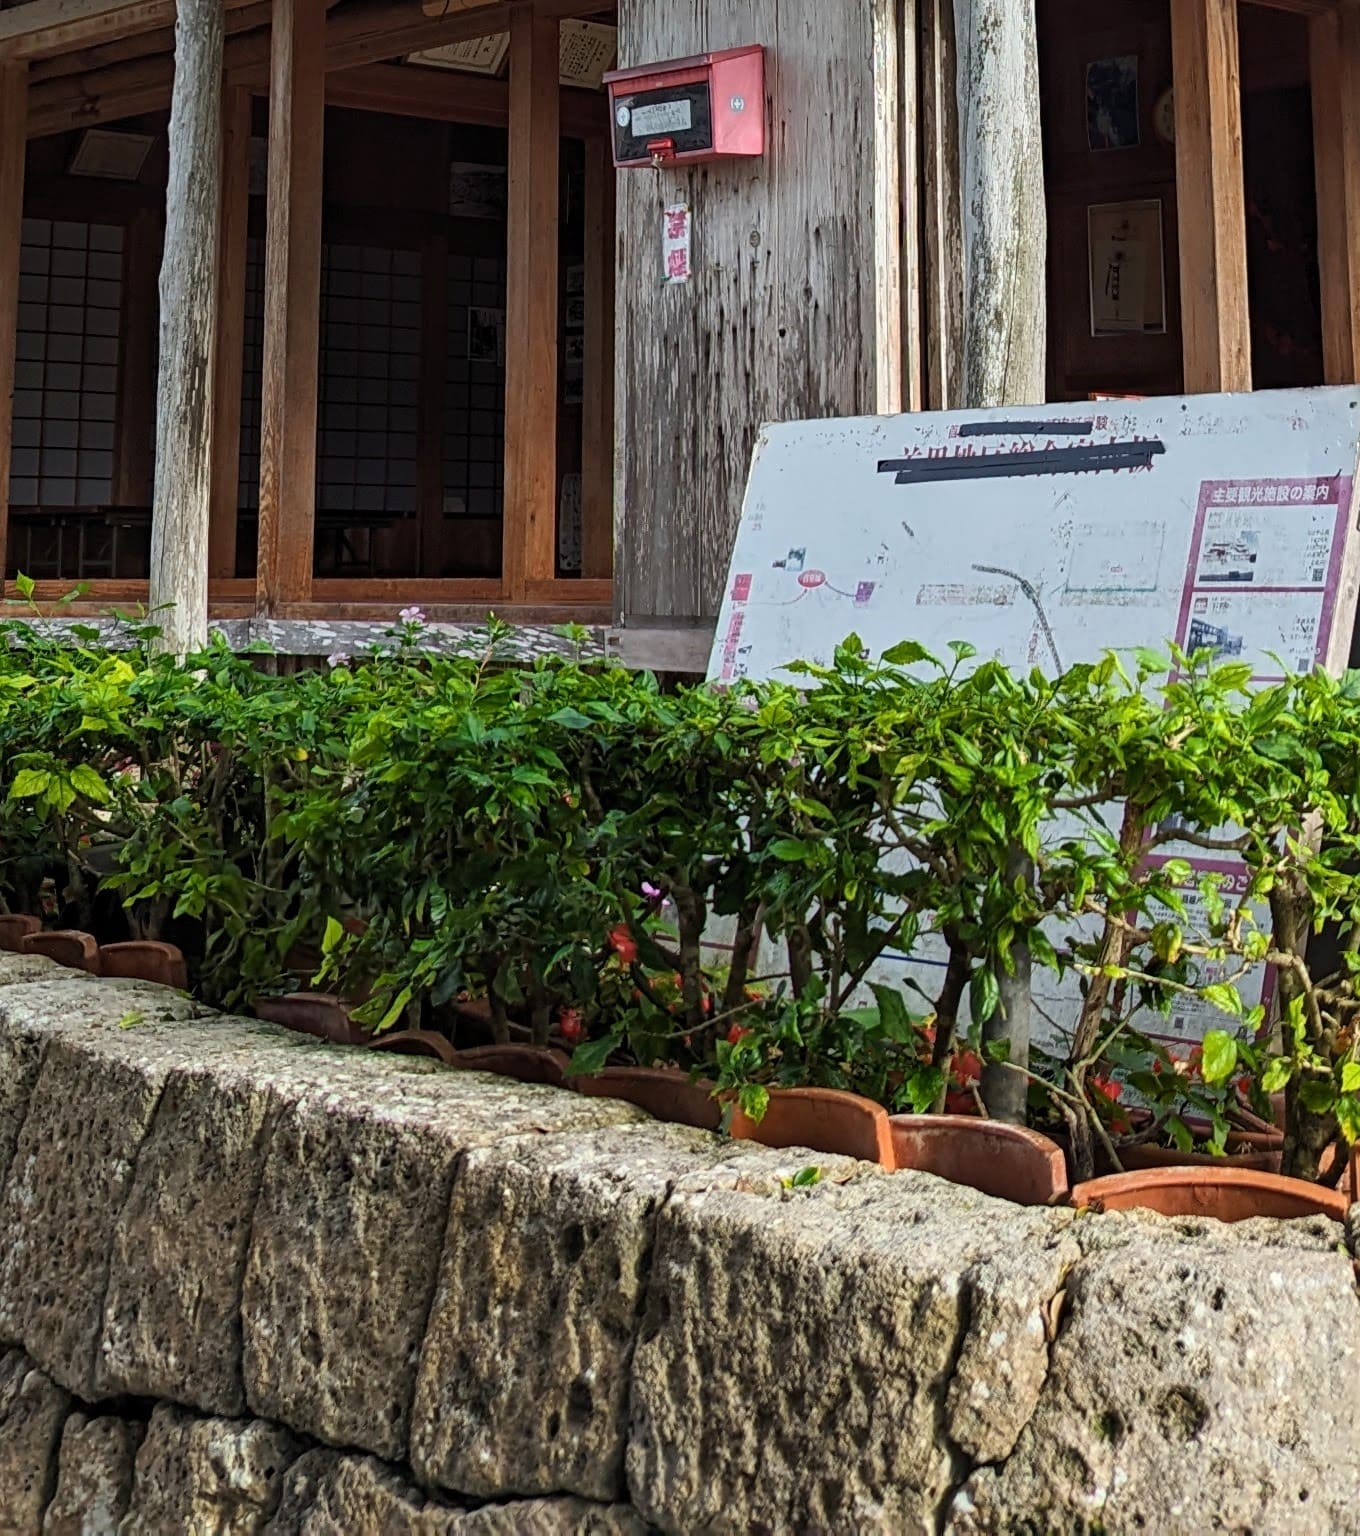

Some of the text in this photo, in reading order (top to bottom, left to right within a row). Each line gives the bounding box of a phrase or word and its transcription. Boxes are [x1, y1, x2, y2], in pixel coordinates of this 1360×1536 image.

[1211, 484, 1330, 503] 主要観光施設の案内
